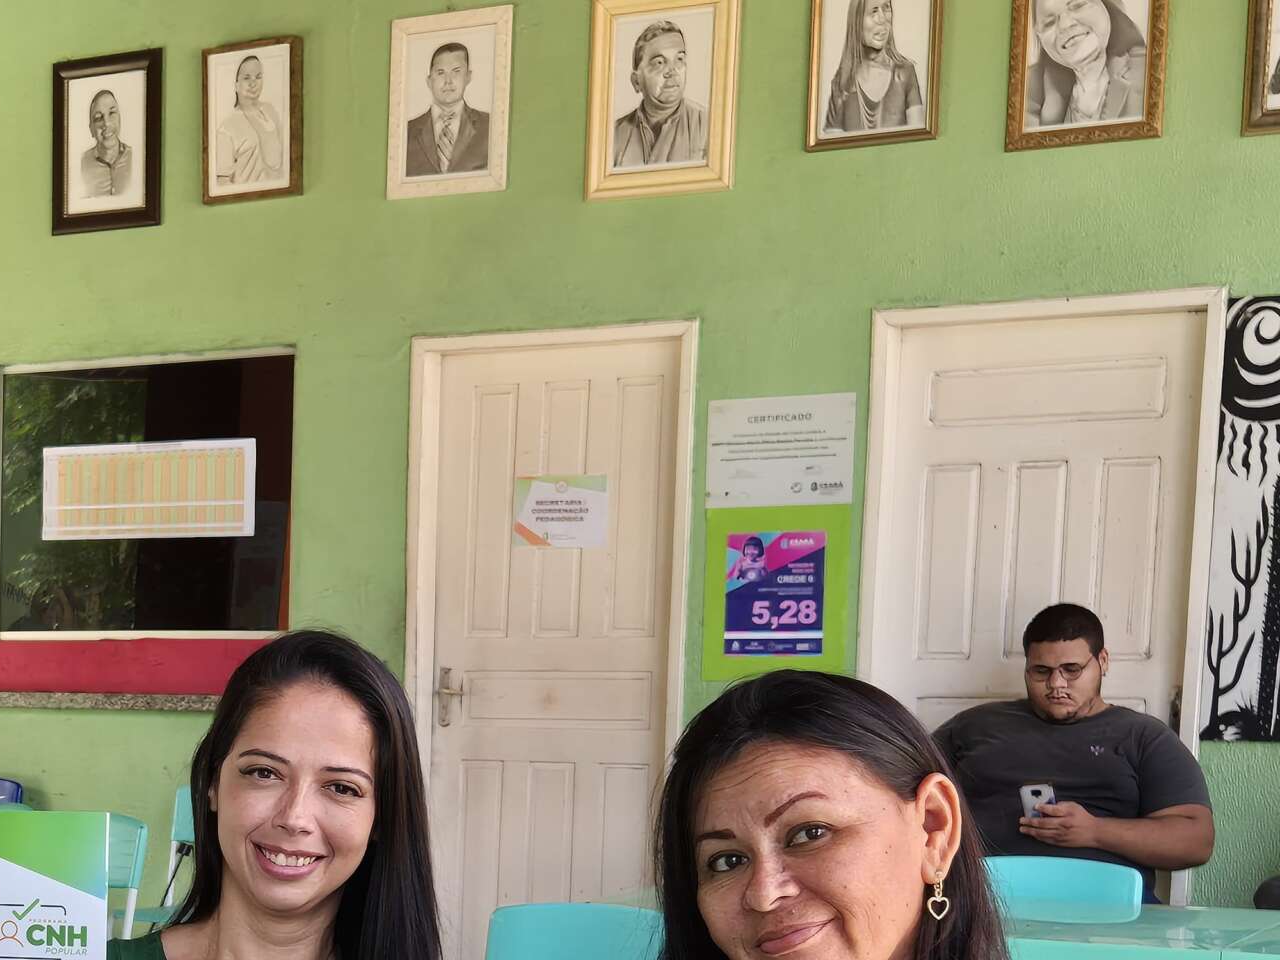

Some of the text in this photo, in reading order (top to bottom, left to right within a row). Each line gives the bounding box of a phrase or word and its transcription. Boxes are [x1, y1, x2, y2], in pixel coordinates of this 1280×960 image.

[747, 412, 813, 424] CERTIFICADO
[751, 599, 817, 629] 5,28
[26, 924, 88, 947] CNH
